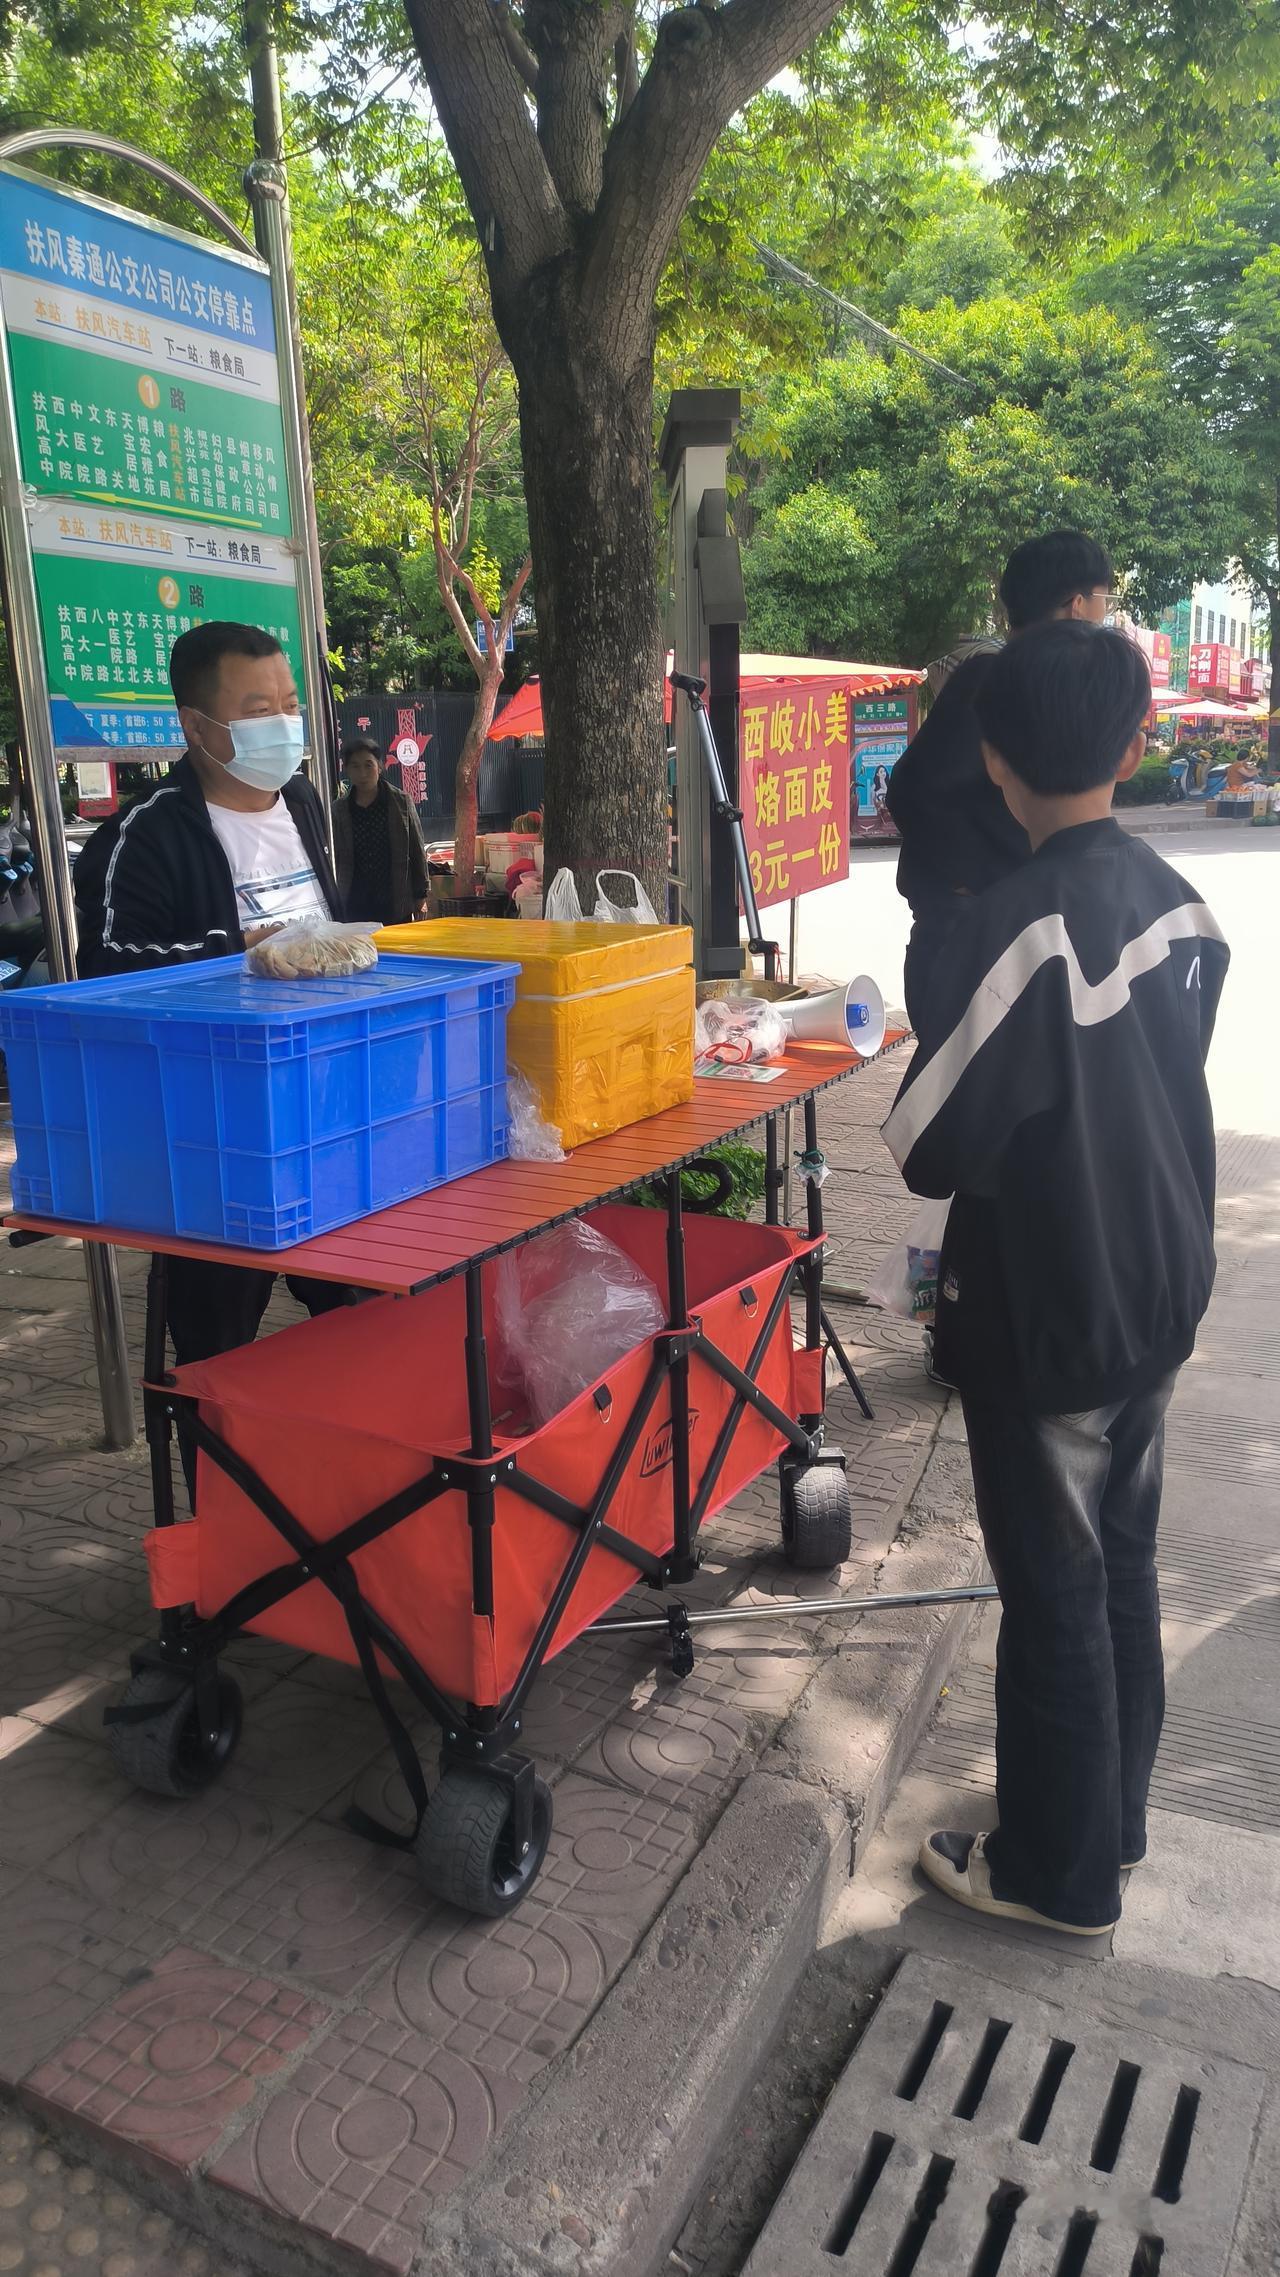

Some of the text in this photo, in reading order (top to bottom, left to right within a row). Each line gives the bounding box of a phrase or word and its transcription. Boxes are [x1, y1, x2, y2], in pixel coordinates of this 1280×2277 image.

[25, 219, 257, 337] 扶风秦通公交公司公交停靠点
[32, 391, 54, 478] 扶风高中
[170, 387, 186, 413] 路
[51, 396, 74, 481] 西大院
[69, 400, 91, 484] 中医院
[87, 404, 108, 487] 文艺路
[104, 408, 124, 490] 东关
[153, 419, 171, 499] 粮食局
[226, 437, 241, 512] 县政府
[240, 440, 255, 515] 烟草公司
[253, 443, 267, 517] 移动公司
[189, 585, 204, 608] 路
[58, 604, 77, 681] 扶风高中
[74, 606, 94, 682] 西大院
[91, 608, 109, 682] 八一路
[107, 609, 124, 683] 中医院北
[122, 610, 140, 684] 文艺路北
[137, 611, 154, 684] 东关
[743, 691, 848, 762] 西岐小美
[865, 703, 896, 713] 西三路
[755, 759, 833, 828] 烙面皮
[750, 822, 841, 896] 3元一份
